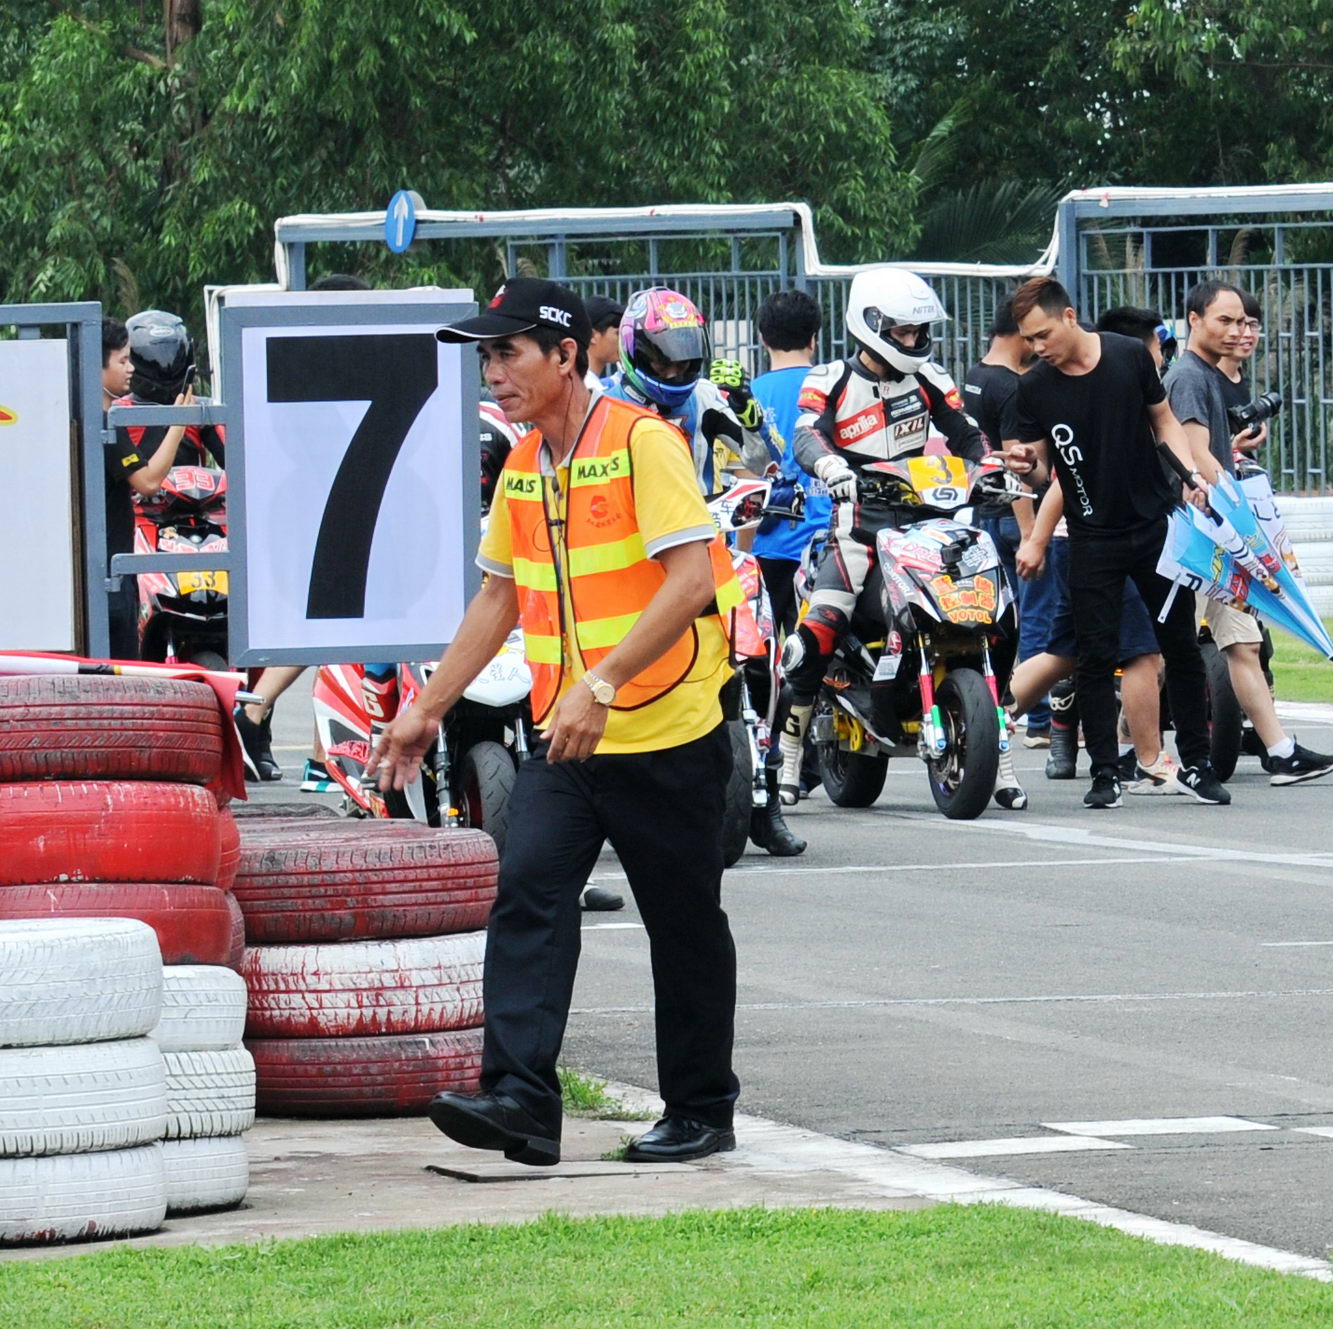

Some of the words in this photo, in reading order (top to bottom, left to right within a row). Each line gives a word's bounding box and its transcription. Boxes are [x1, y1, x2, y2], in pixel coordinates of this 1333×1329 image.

[539, 305, 572, 327] SCKC
[839, 413, 879, 440] aprilia
[895, 418, 925, 437] IXIL
[266, 334, 438, 620] 7
[927, 455, 952, 485] 3
[1051, 423, 1084, 466] QS
[1069, 467, 1094, 517] MOTOR
[947, 609, 993, 624] VOTOL
